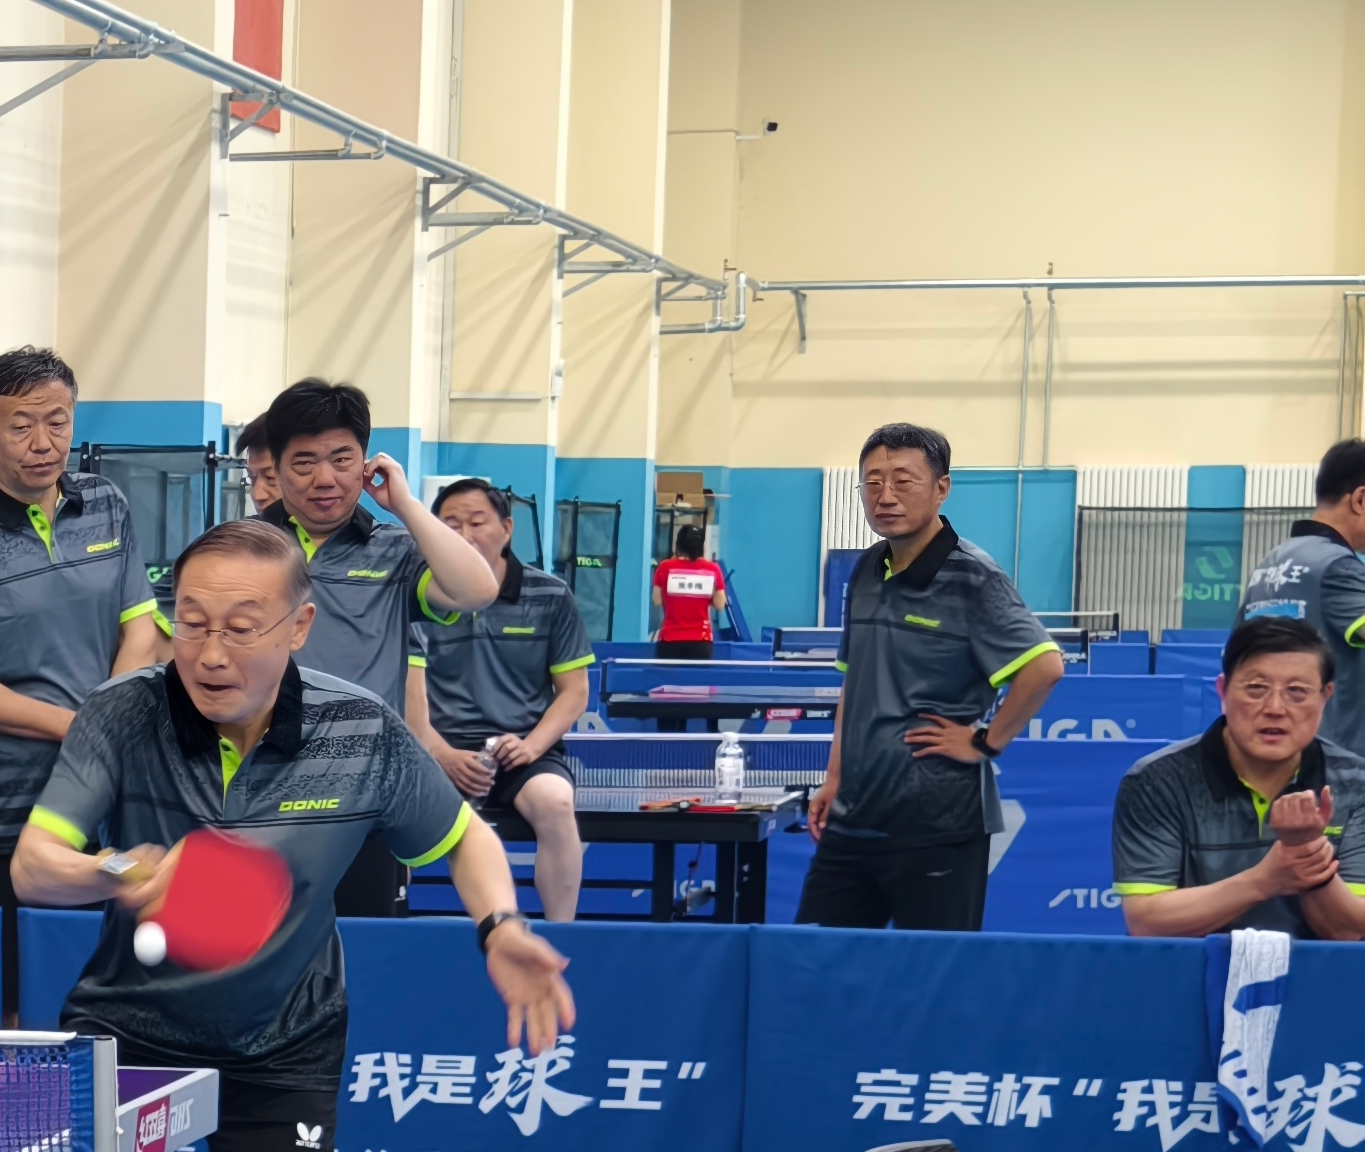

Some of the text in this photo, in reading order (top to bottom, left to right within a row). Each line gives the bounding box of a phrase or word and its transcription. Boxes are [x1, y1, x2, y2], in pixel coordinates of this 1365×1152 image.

[278, 798, 340, 812] DONIC
[1049, 887, 1122, 909] STIG
[170, 1098, 195, 1137] DHS
